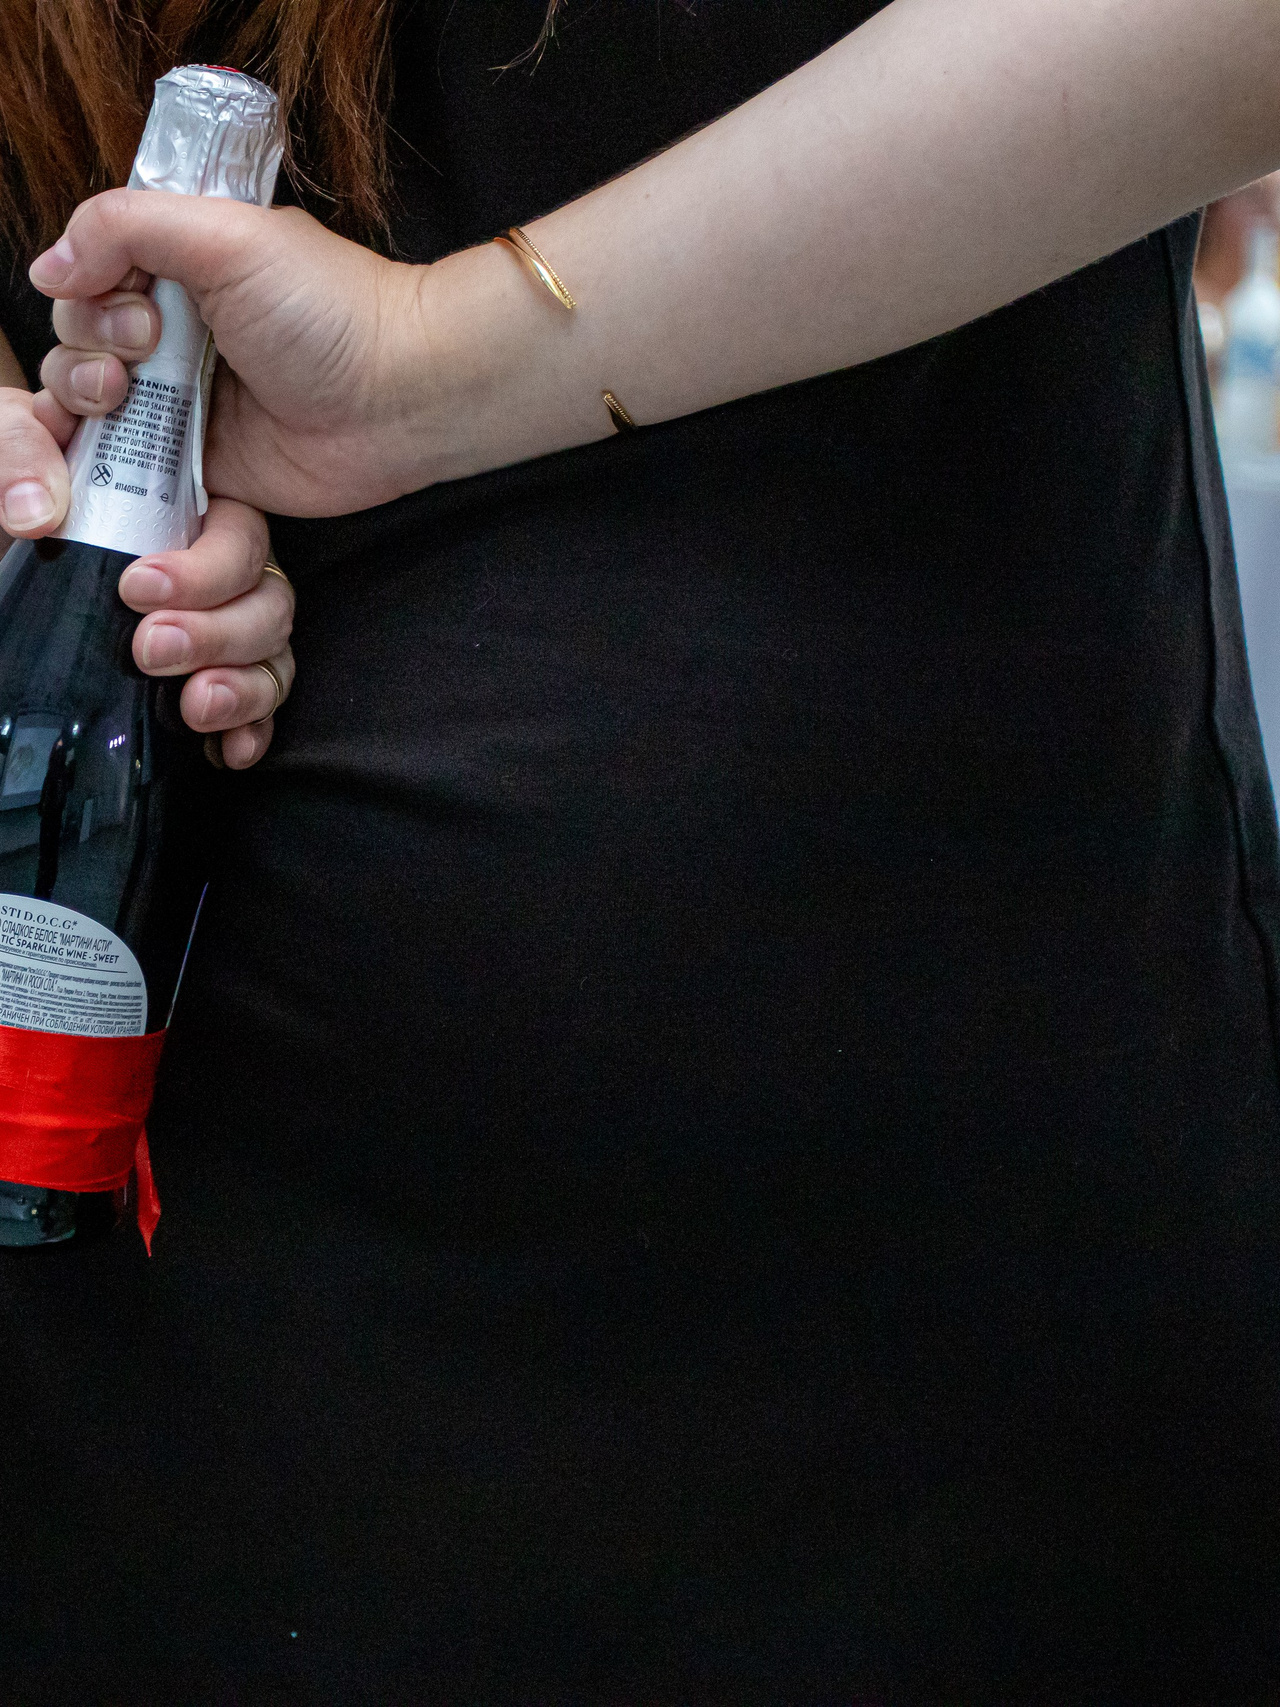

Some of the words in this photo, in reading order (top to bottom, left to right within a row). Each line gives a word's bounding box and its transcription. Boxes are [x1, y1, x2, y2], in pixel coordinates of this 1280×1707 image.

[131, 376, 179, 395] WARNING:
[136, 388, 154, 399] UNDER
[132, 398, 149, 408] AVOID
[122, 416, 137, 426] WHEN
[162, 425, 174, 435] HOLD
[128, 407, 144, 417] AWAY
[146, 411, 162, 421] FROM
[165, 415, 176, 425] SELF
[102, 422, 121, 432] FIRMLY
[123, 426, 139, 436] WHEN
[142, 430, 170, 444] REMOVING
[114, 435, 130, 444] TWIST
[130, 438, 141, 447] OUT
[141, 440, 161, 451] SLOWLY
[162, 445, 168, 453] BY
[95, 451, 108, 460] HARD
[110, 453, 117, 462] OR
[118, 455, 136, 465] SHARP
[137, 459, 156, 470] OBJECT
[157, 464, 163, 473] TO
[97, 442, 112, 451] NEVER
[113, 445, 122, 454] USE
[128, 448, 157, 461] CORKSCREW
[157, 455, 165, 463] OR
[165, 457, 179, 467] OTHER
[1, 919, 34, 940] СЛАДКОЕ
[34, 927, 58, 944] БЕЛОЕ
[16, 938, 64, 956] SPARKLING
[66, 948, 87, 961] WINE
[93, 953, 119, 964] SWEET
[30, 1015, 44, 1027] ПРИ
[44, 1018, 89, 1032] СОБЛЮДЕНИИ
